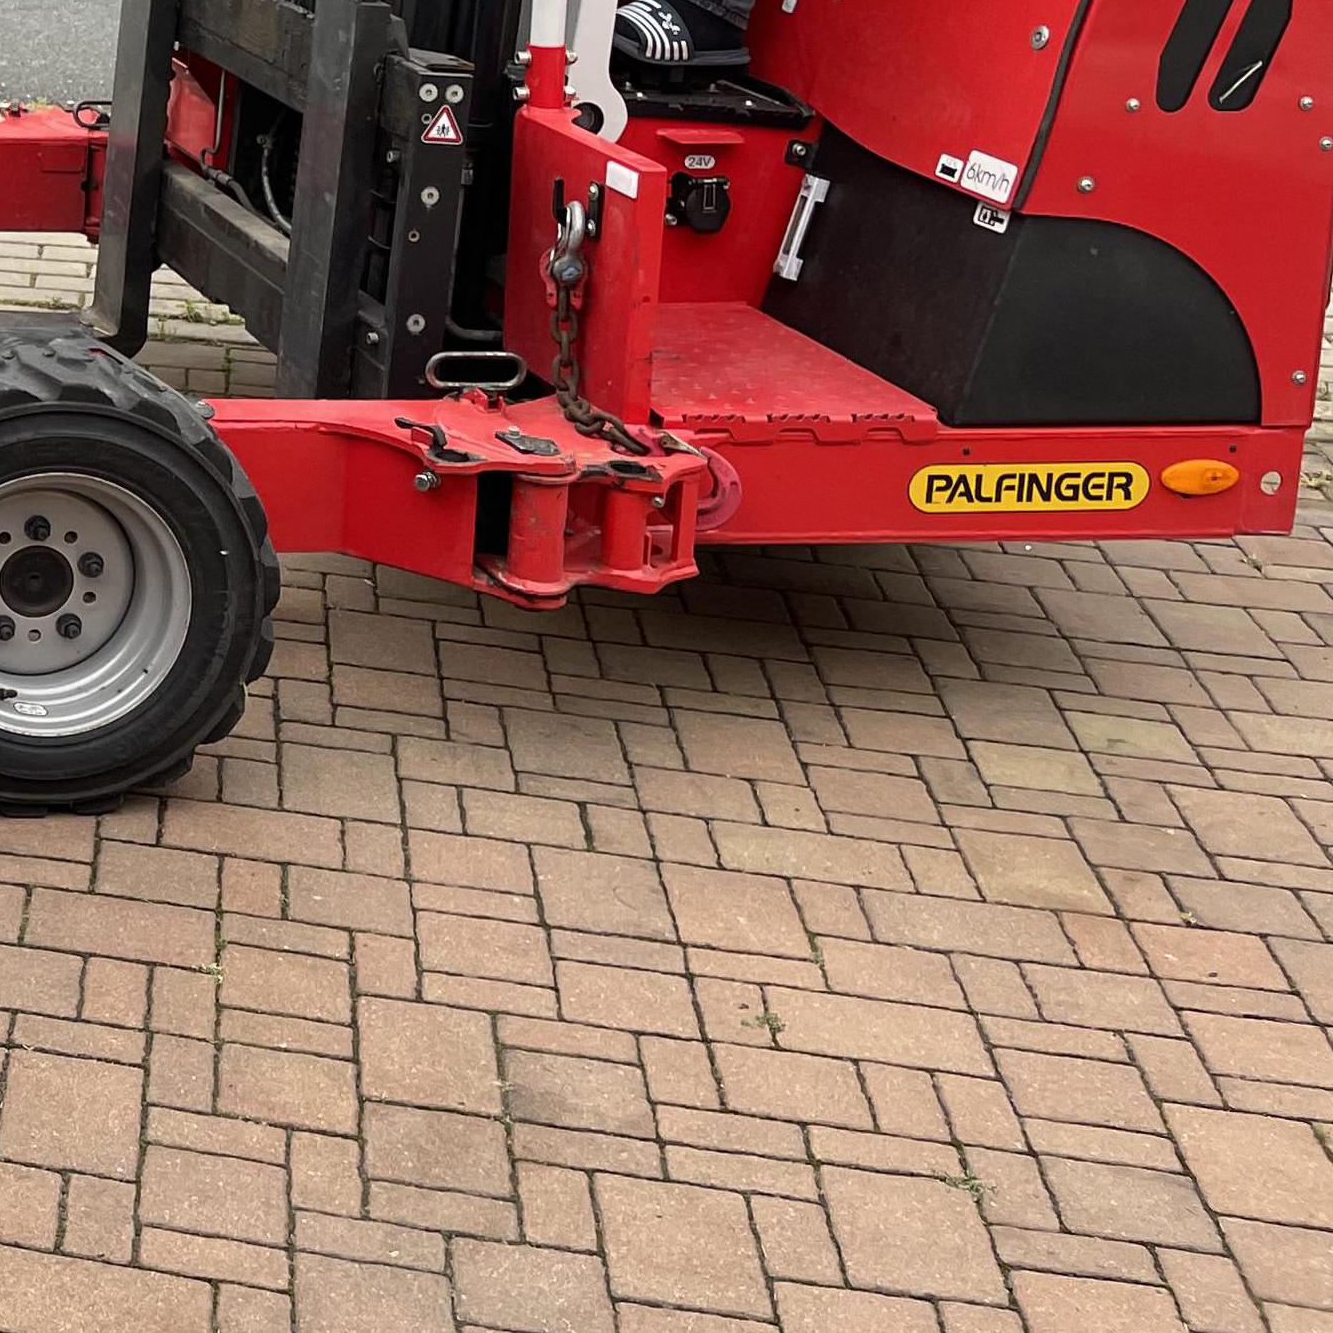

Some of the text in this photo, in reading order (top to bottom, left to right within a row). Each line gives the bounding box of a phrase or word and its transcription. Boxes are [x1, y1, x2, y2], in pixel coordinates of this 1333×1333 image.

[688, 157, 712, 167] 24V
[966, 162, 1010, 194] 6km/h
[925, 472, 1133, 504] PALFINGER
